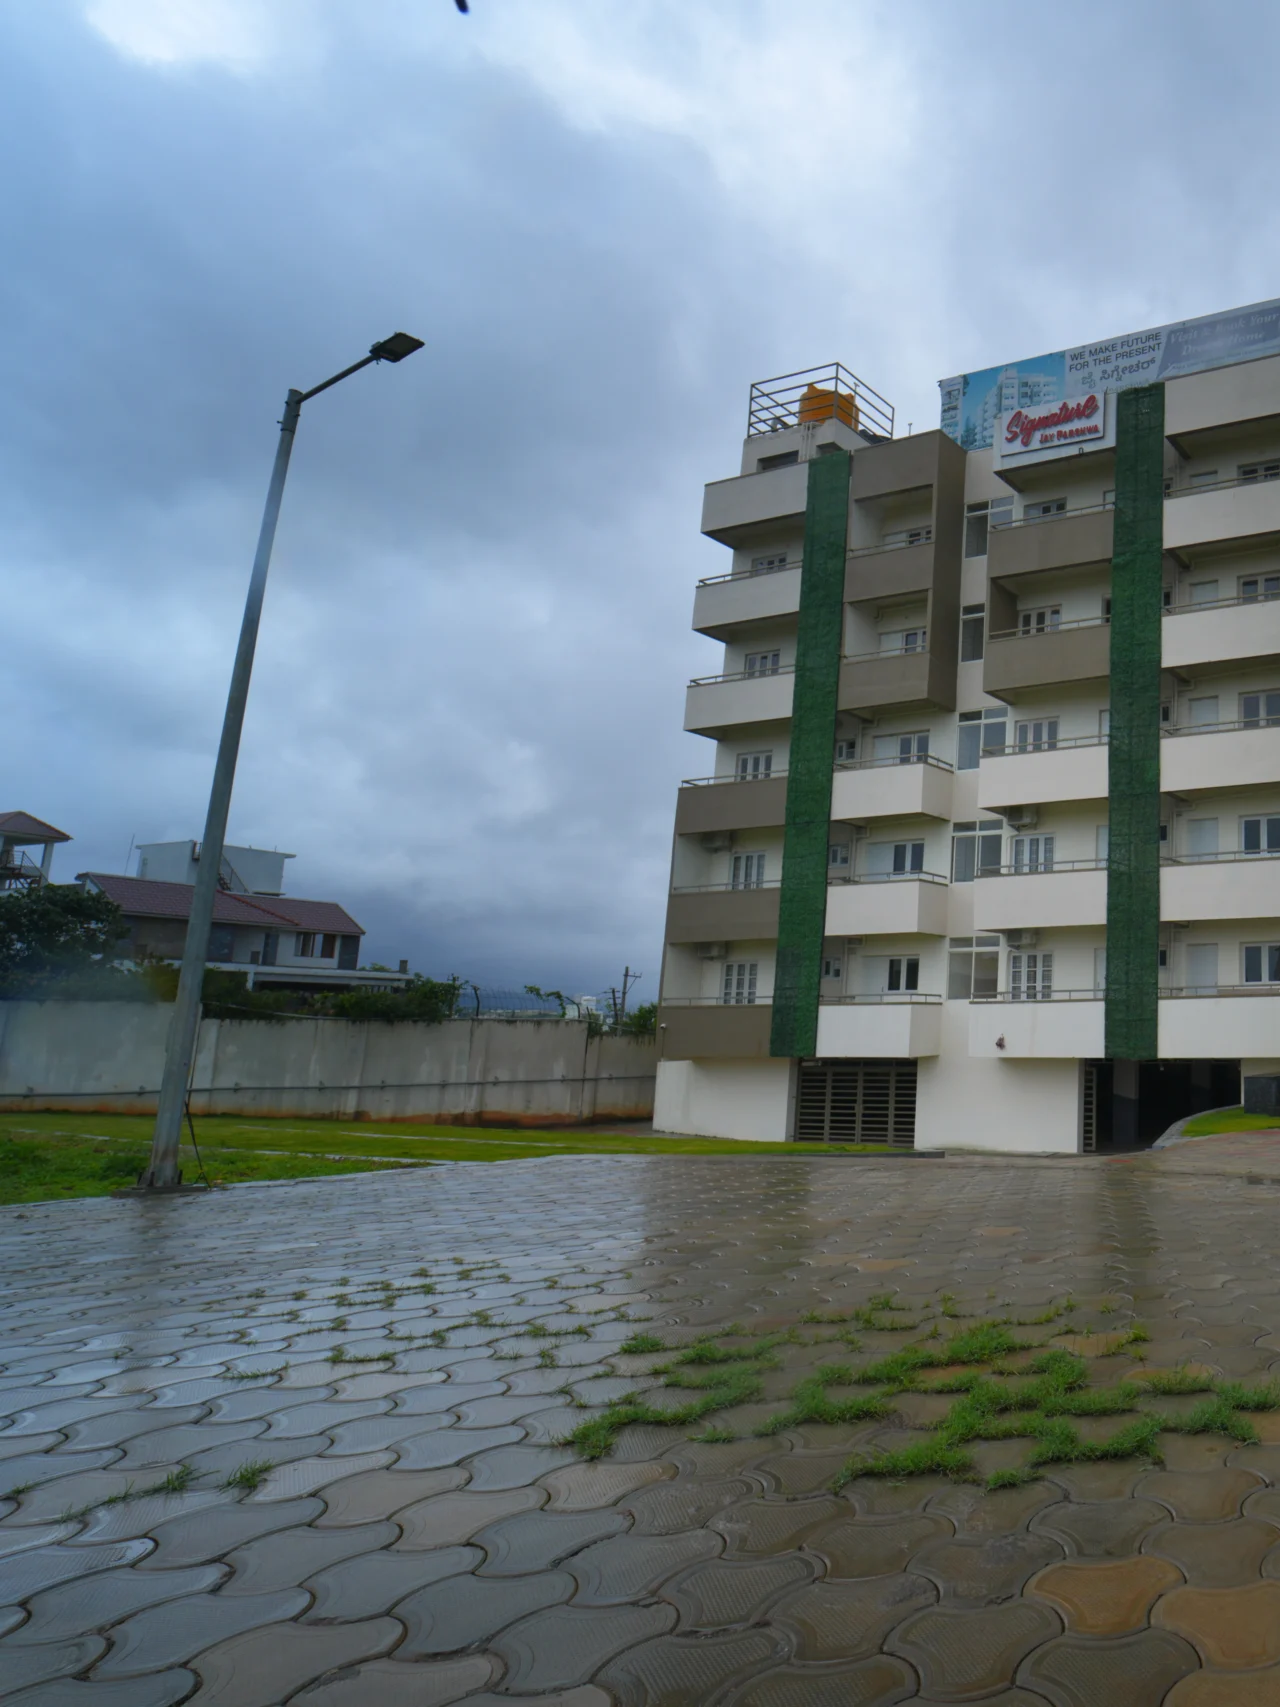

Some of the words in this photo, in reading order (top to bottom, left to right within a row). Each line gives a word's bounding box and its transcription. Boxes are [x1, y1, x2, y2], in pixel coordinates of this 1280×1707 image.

[1170, 328, 1197, 344] Visit
[1249, 313, 1279, 326] Your
[1069, 360, 1089, 372] FOR
[1092, 355, 1112, 367] THE
[1115, 342, 1162, 361] PRESENT
[1070, 351, 1086, 362] WE
[1088, 343, 1117, 357] MAKE
[1120, 332, 1162, 349] FUTURE
[1181, 337, 1227, 356] Dre
[1005, 394, 1099, 447] Signature
[1039, 432, 1055, 444] JAY
[1056, 424, 1099, 441] PARSHWA
